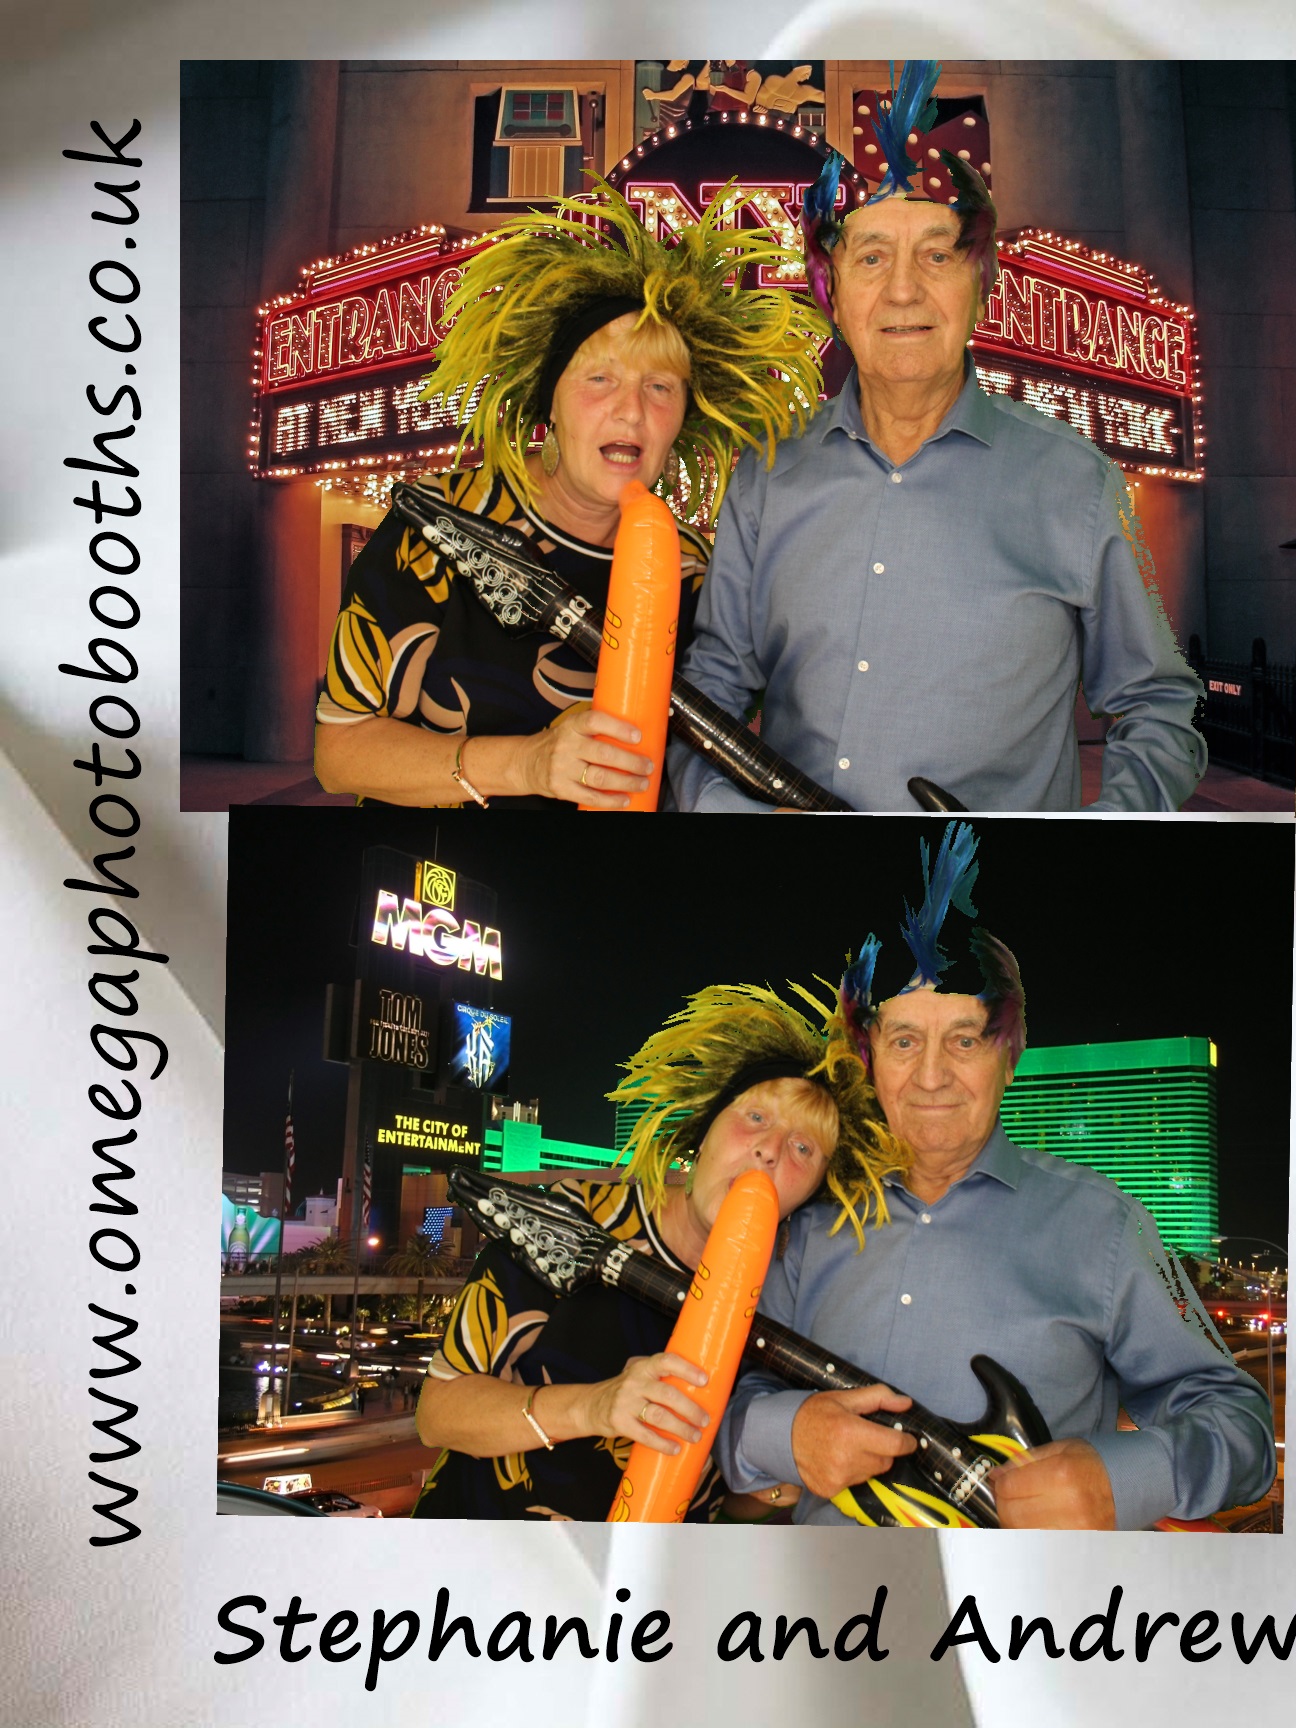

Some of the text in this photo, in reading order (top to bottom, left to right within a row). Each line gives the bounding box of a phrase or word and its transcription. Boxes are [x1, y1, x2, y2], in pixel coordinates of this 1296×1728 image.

[267, 267, 467, 382] ENTRANC
[1209, 680, 1242, 696] EXIT ONLY
[371, 889, 503, 981] MGM
[379, 988, 423, 1031] TOM
[457, 1004, 480, 1018] CIRQUE
[369, 1026, 430, 1069] JONES
[377, 1128, 481, 1156] ENTERTAINMENT
[395, 1114, 469, 1138] THE CITY OF
